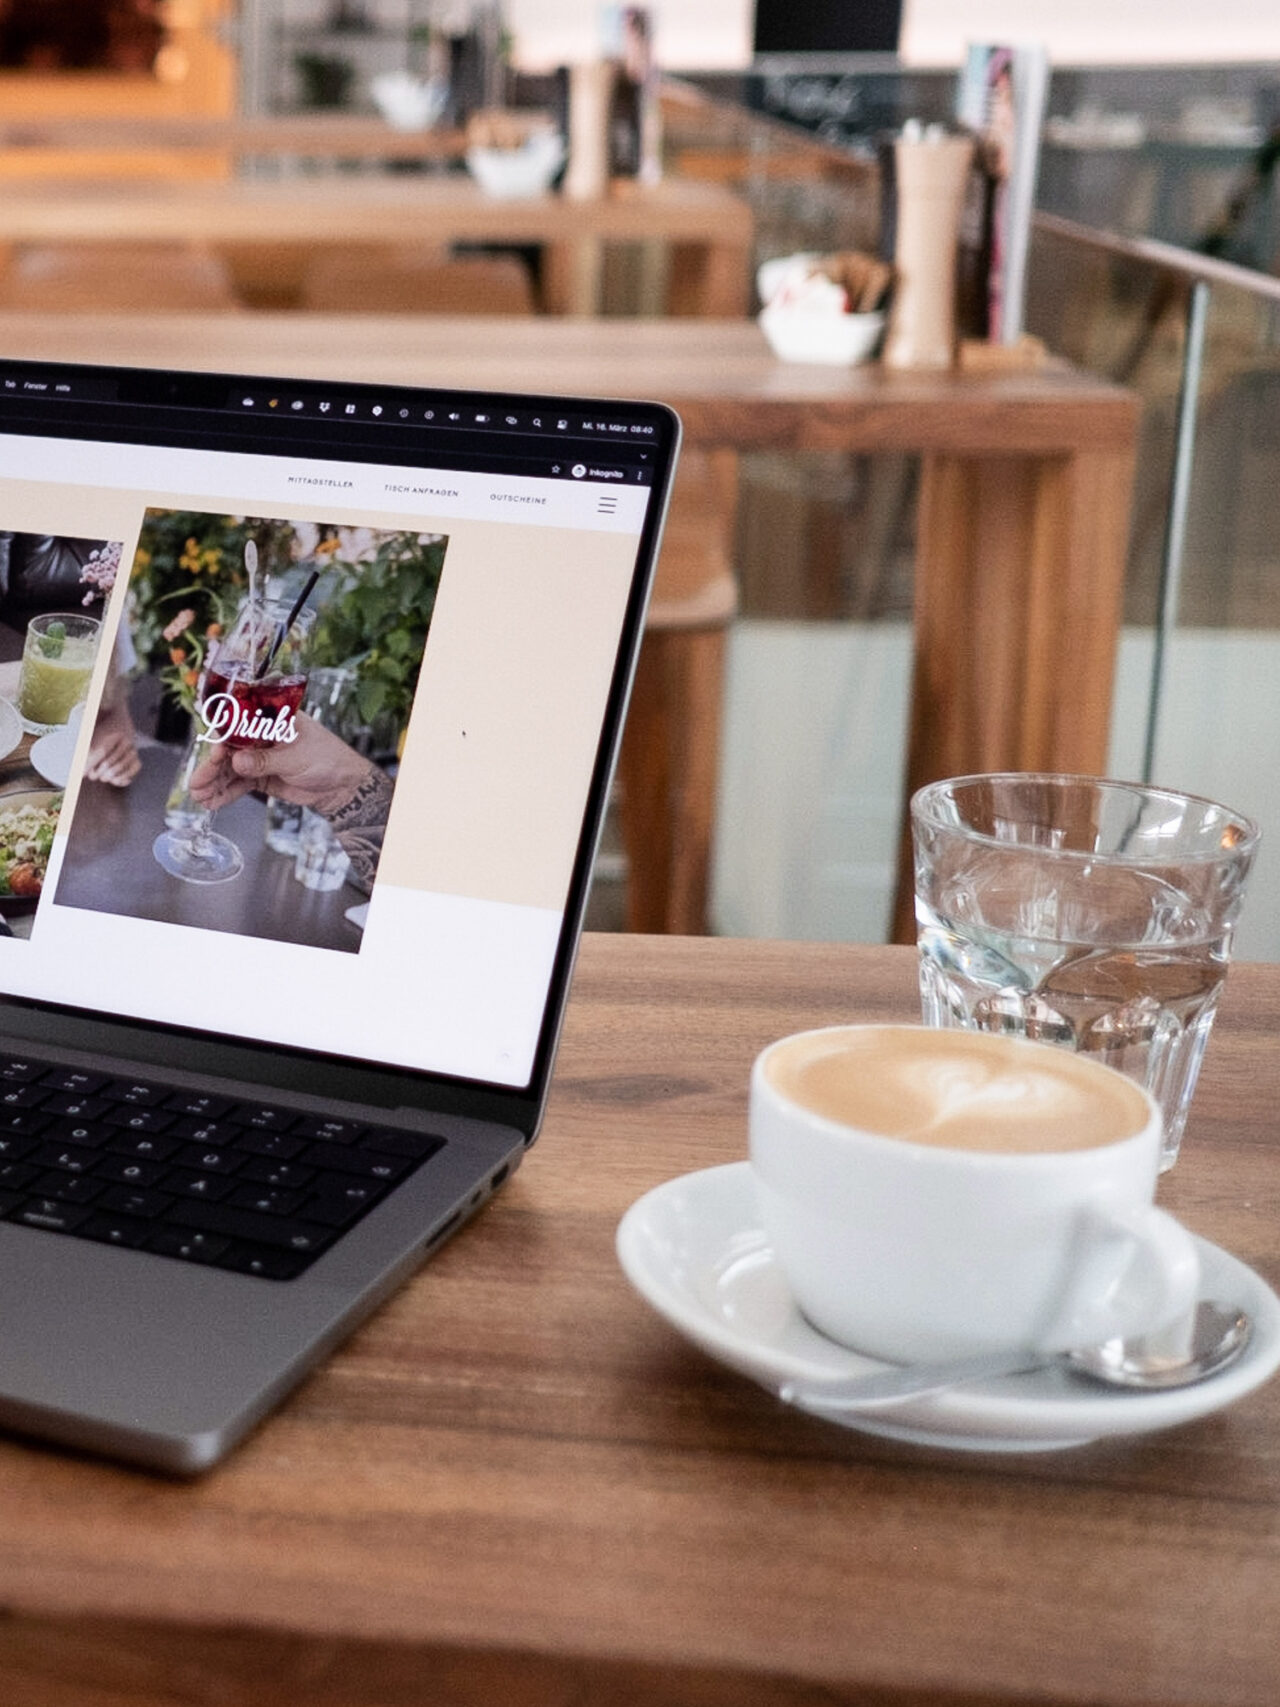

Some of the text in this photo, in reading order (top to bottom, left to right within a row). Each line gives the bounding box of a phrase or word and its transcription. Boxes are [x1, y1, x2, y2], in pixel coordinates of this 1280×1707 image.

[5, 380, 17, 389] Tab
[24, 381, 48, 391] Fenster
[608, 424, 628, 433] März
[630, 425, 654, 434] 08:40
[589, 468, 624, 479] Inkognito
[384, 483, 459, 498] TISCH ANFRAGEN
[489, 493, 547, 505] GUTSCHEINE
[196, 692, 299, 745] Drinks
[72, 1128, 88, 1137] O
